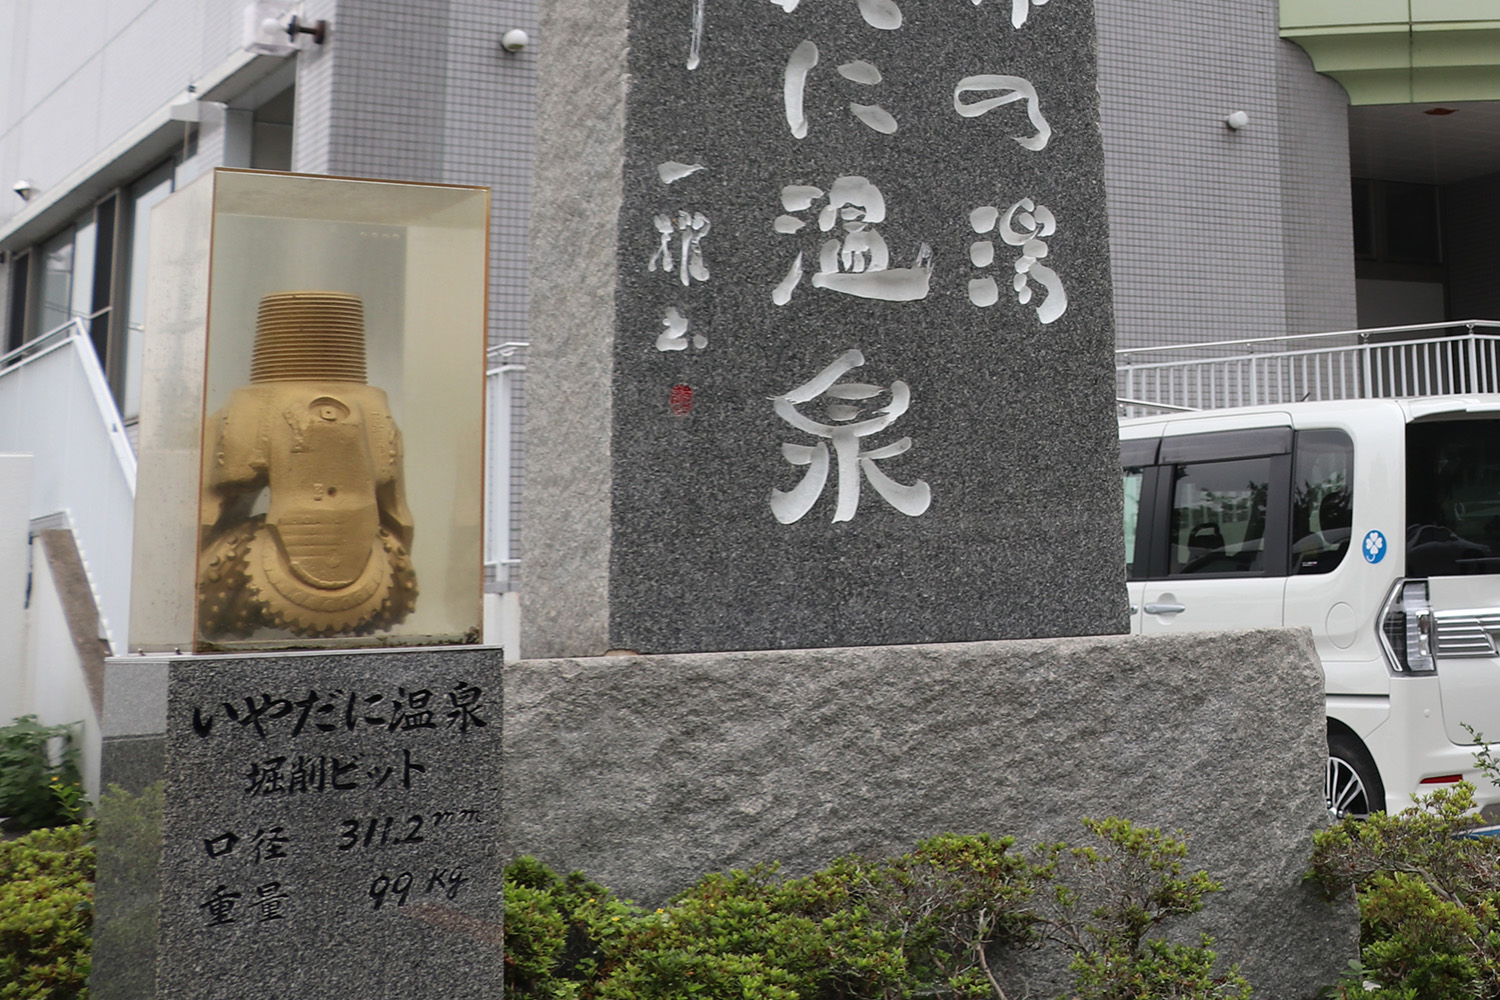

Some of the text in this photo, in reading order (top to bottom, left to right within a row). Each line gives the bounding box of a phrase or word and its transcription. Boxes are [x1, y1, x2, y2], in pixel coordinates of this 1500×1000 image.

[192, 681, 488, 739] いやだに温泉
[204, 827, 290, 865] 口径
[199, 881, 290, 928] 重量
